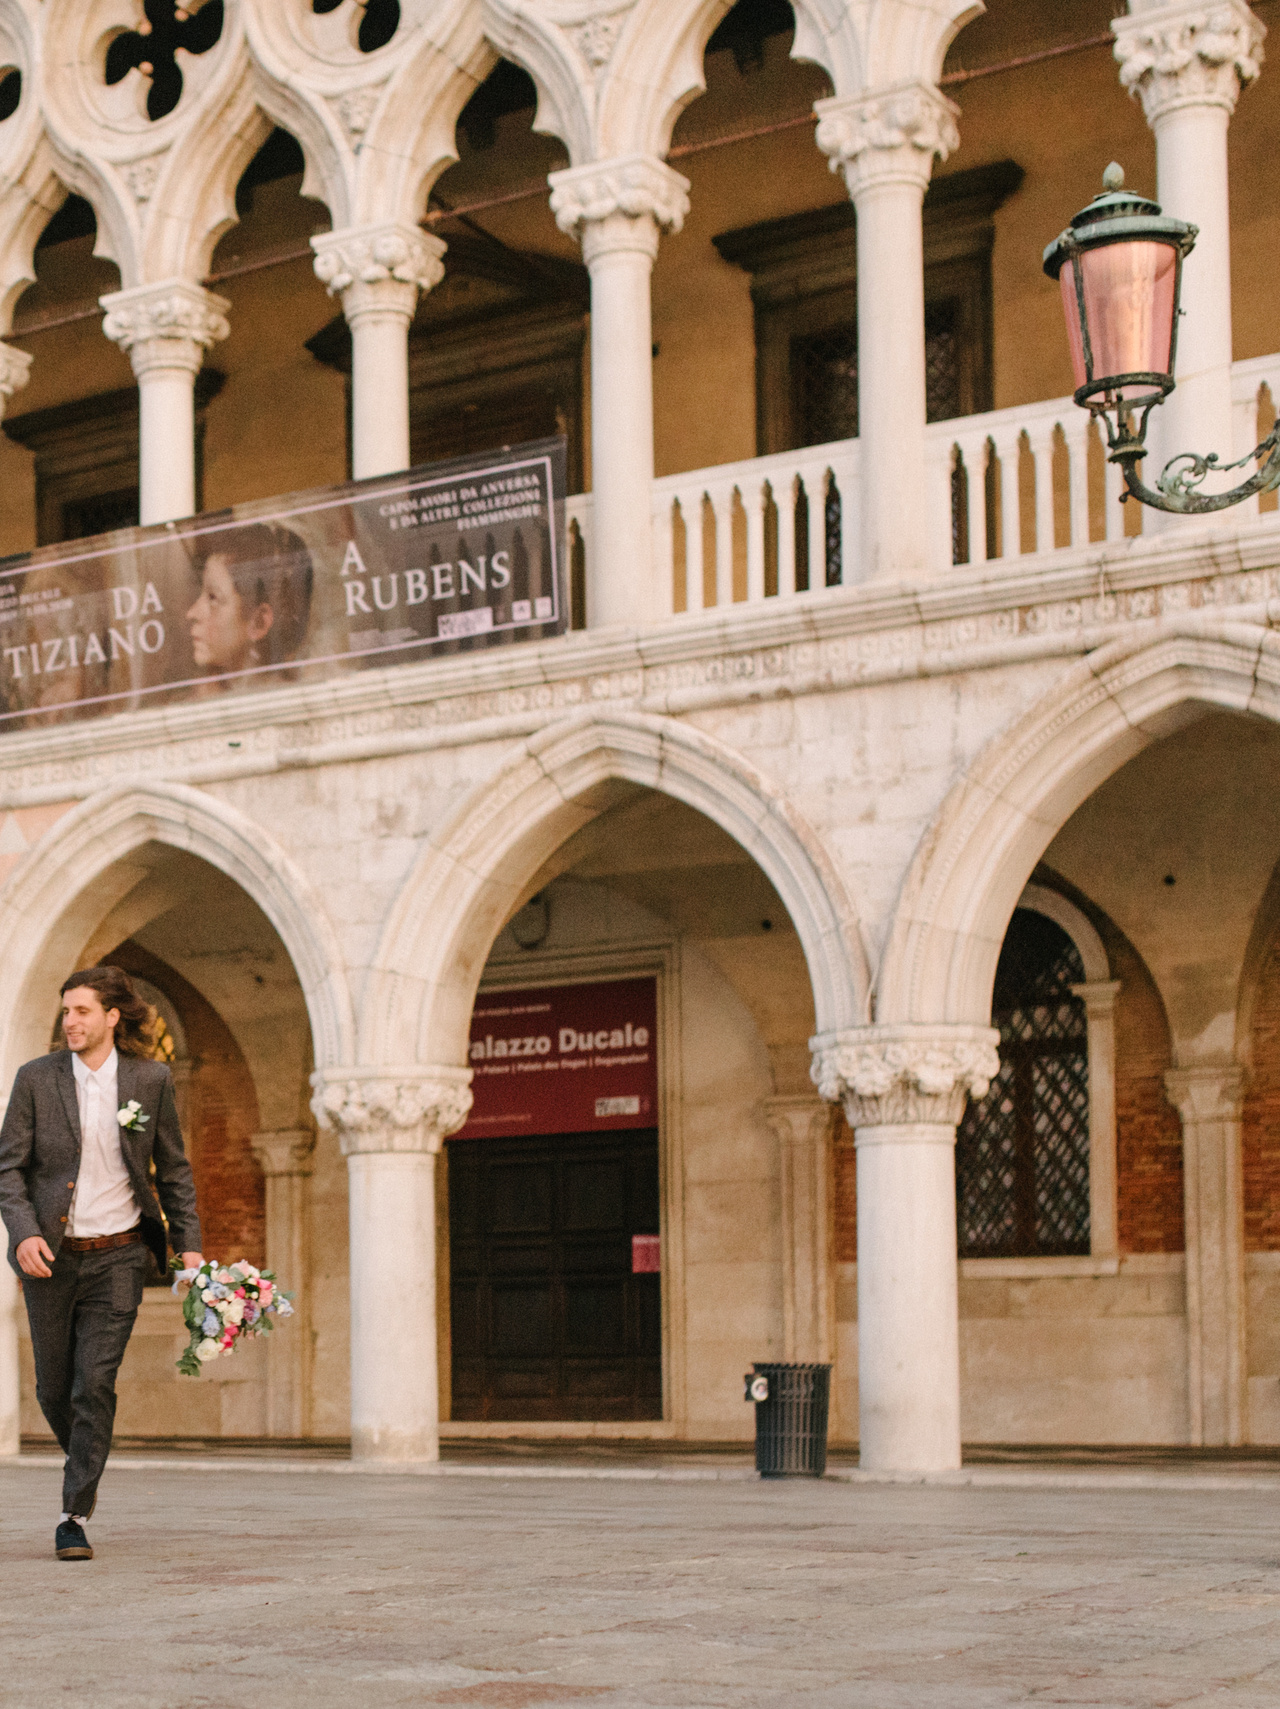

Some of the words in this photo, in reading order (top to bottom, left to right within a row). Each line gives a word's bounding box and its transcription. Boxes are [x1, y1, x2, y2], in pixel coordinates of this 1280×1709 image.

[379, 489, 458, 517] CAPOLAVORI
[459, 486, 478, 501] DA
[480, 473, 540, 496] ANVERSA
[400, 513, 419, 529] DA
[421, 504, 460, 523] ALTRE
[462, 488, 541, 515] COLLEZIONI
[457, 503, 541, 531] FIAMMINGHE
[340, 540, 367, 576] A
[112, 582, 163, 620] DA
[343, 551, 511, 617] RUBENS
[3, 619, 165, 679] TIZIANO
[470, 1034, 551, 1060] alazzo
[558, 1021, 649, 1053] Ducale
